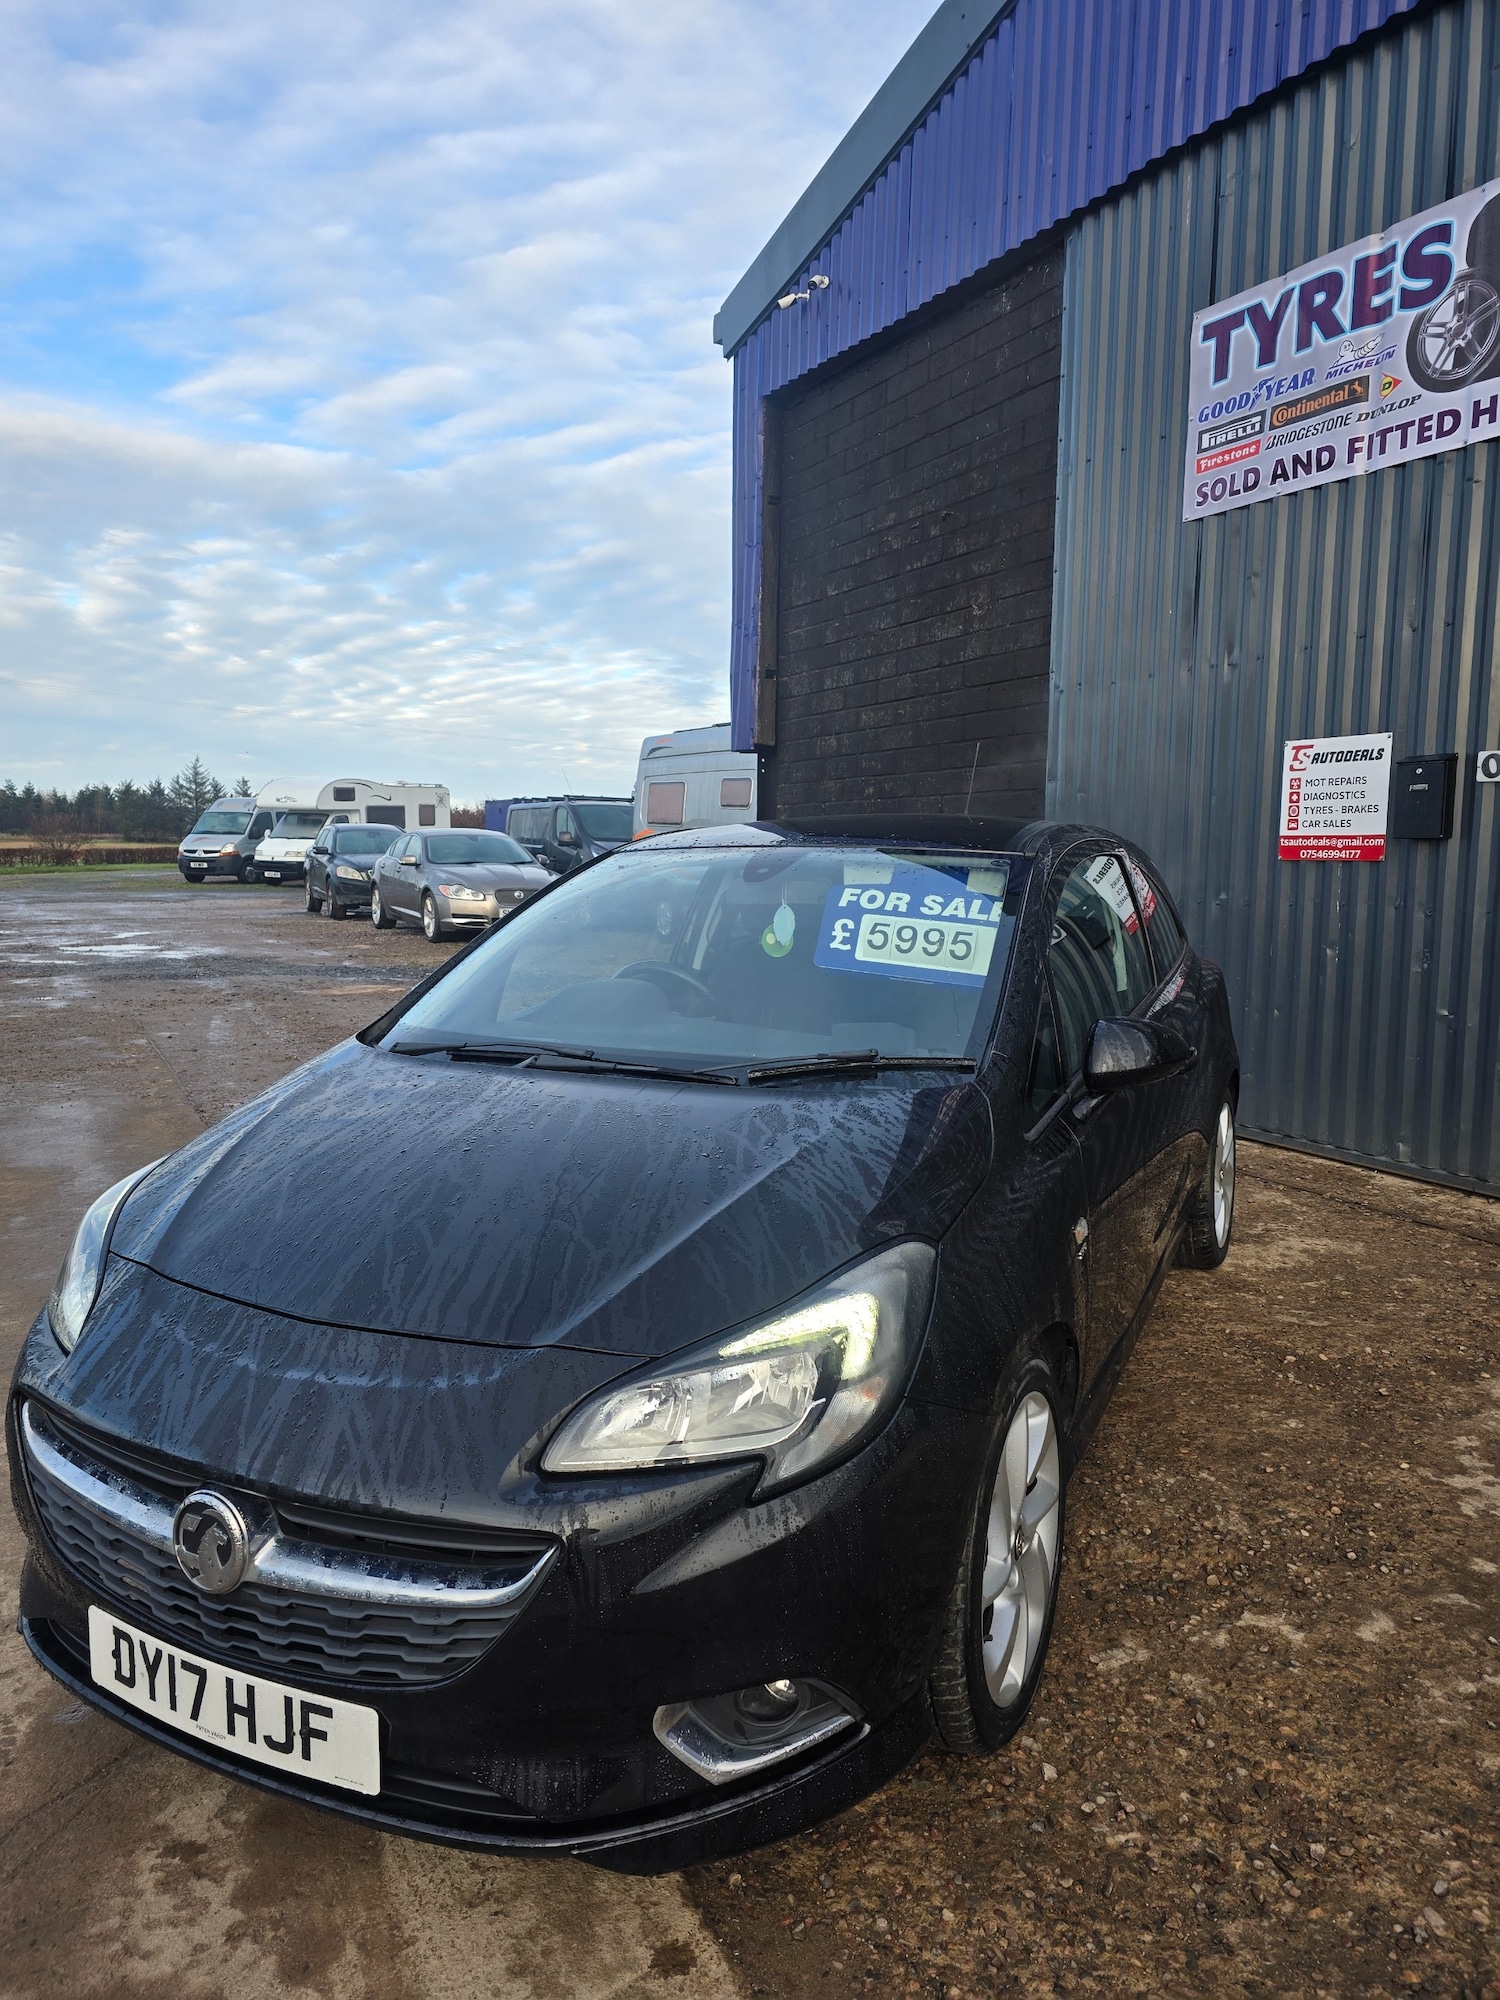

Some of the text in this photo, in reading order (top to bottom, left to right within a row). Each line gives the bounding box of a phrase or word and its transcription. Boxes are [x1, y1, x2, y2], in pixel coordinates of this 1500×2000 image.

[1201, 221, 1454, 386] TYRES
[1325, 349, 1396, 380] MICHELIN
[1272, 385, 1349, 427] Continental
[1355, 394, 1422, 423] DUNLOP
[1201, 415, 1262, 450] PIRELLI
[1265, 412, 1353, 451] BRIDGESTONE
[1195, 465, 1260, 508] SOLD
[1270, 444, 1336, 486] AND
[1347, 408, 1462, 465] FITTED
[1200, 444, 1257, 472] Firestone
[1311, 748, 1385, 765] AUTODEALS
[1305, 776, 1368, 787] MOT REPAIRS
[1303, 791, 1366, 801] DIAGNOSTICS
[1304, 806, 1334, 815] TYRES
[1341, 804, 1379, 814] BRAKES
[1302, 819, 1352, 828] CAR SALES
[1280, 837, 1384, 848] tsautodeals@gmail.com
[1300, 850, 1361, 859] 07546994177
[838, 887, 911, 912] FOR
[829, 918, 974, 961] £ 5995
[112, 1625, 333, 1762] DY17 HJF
